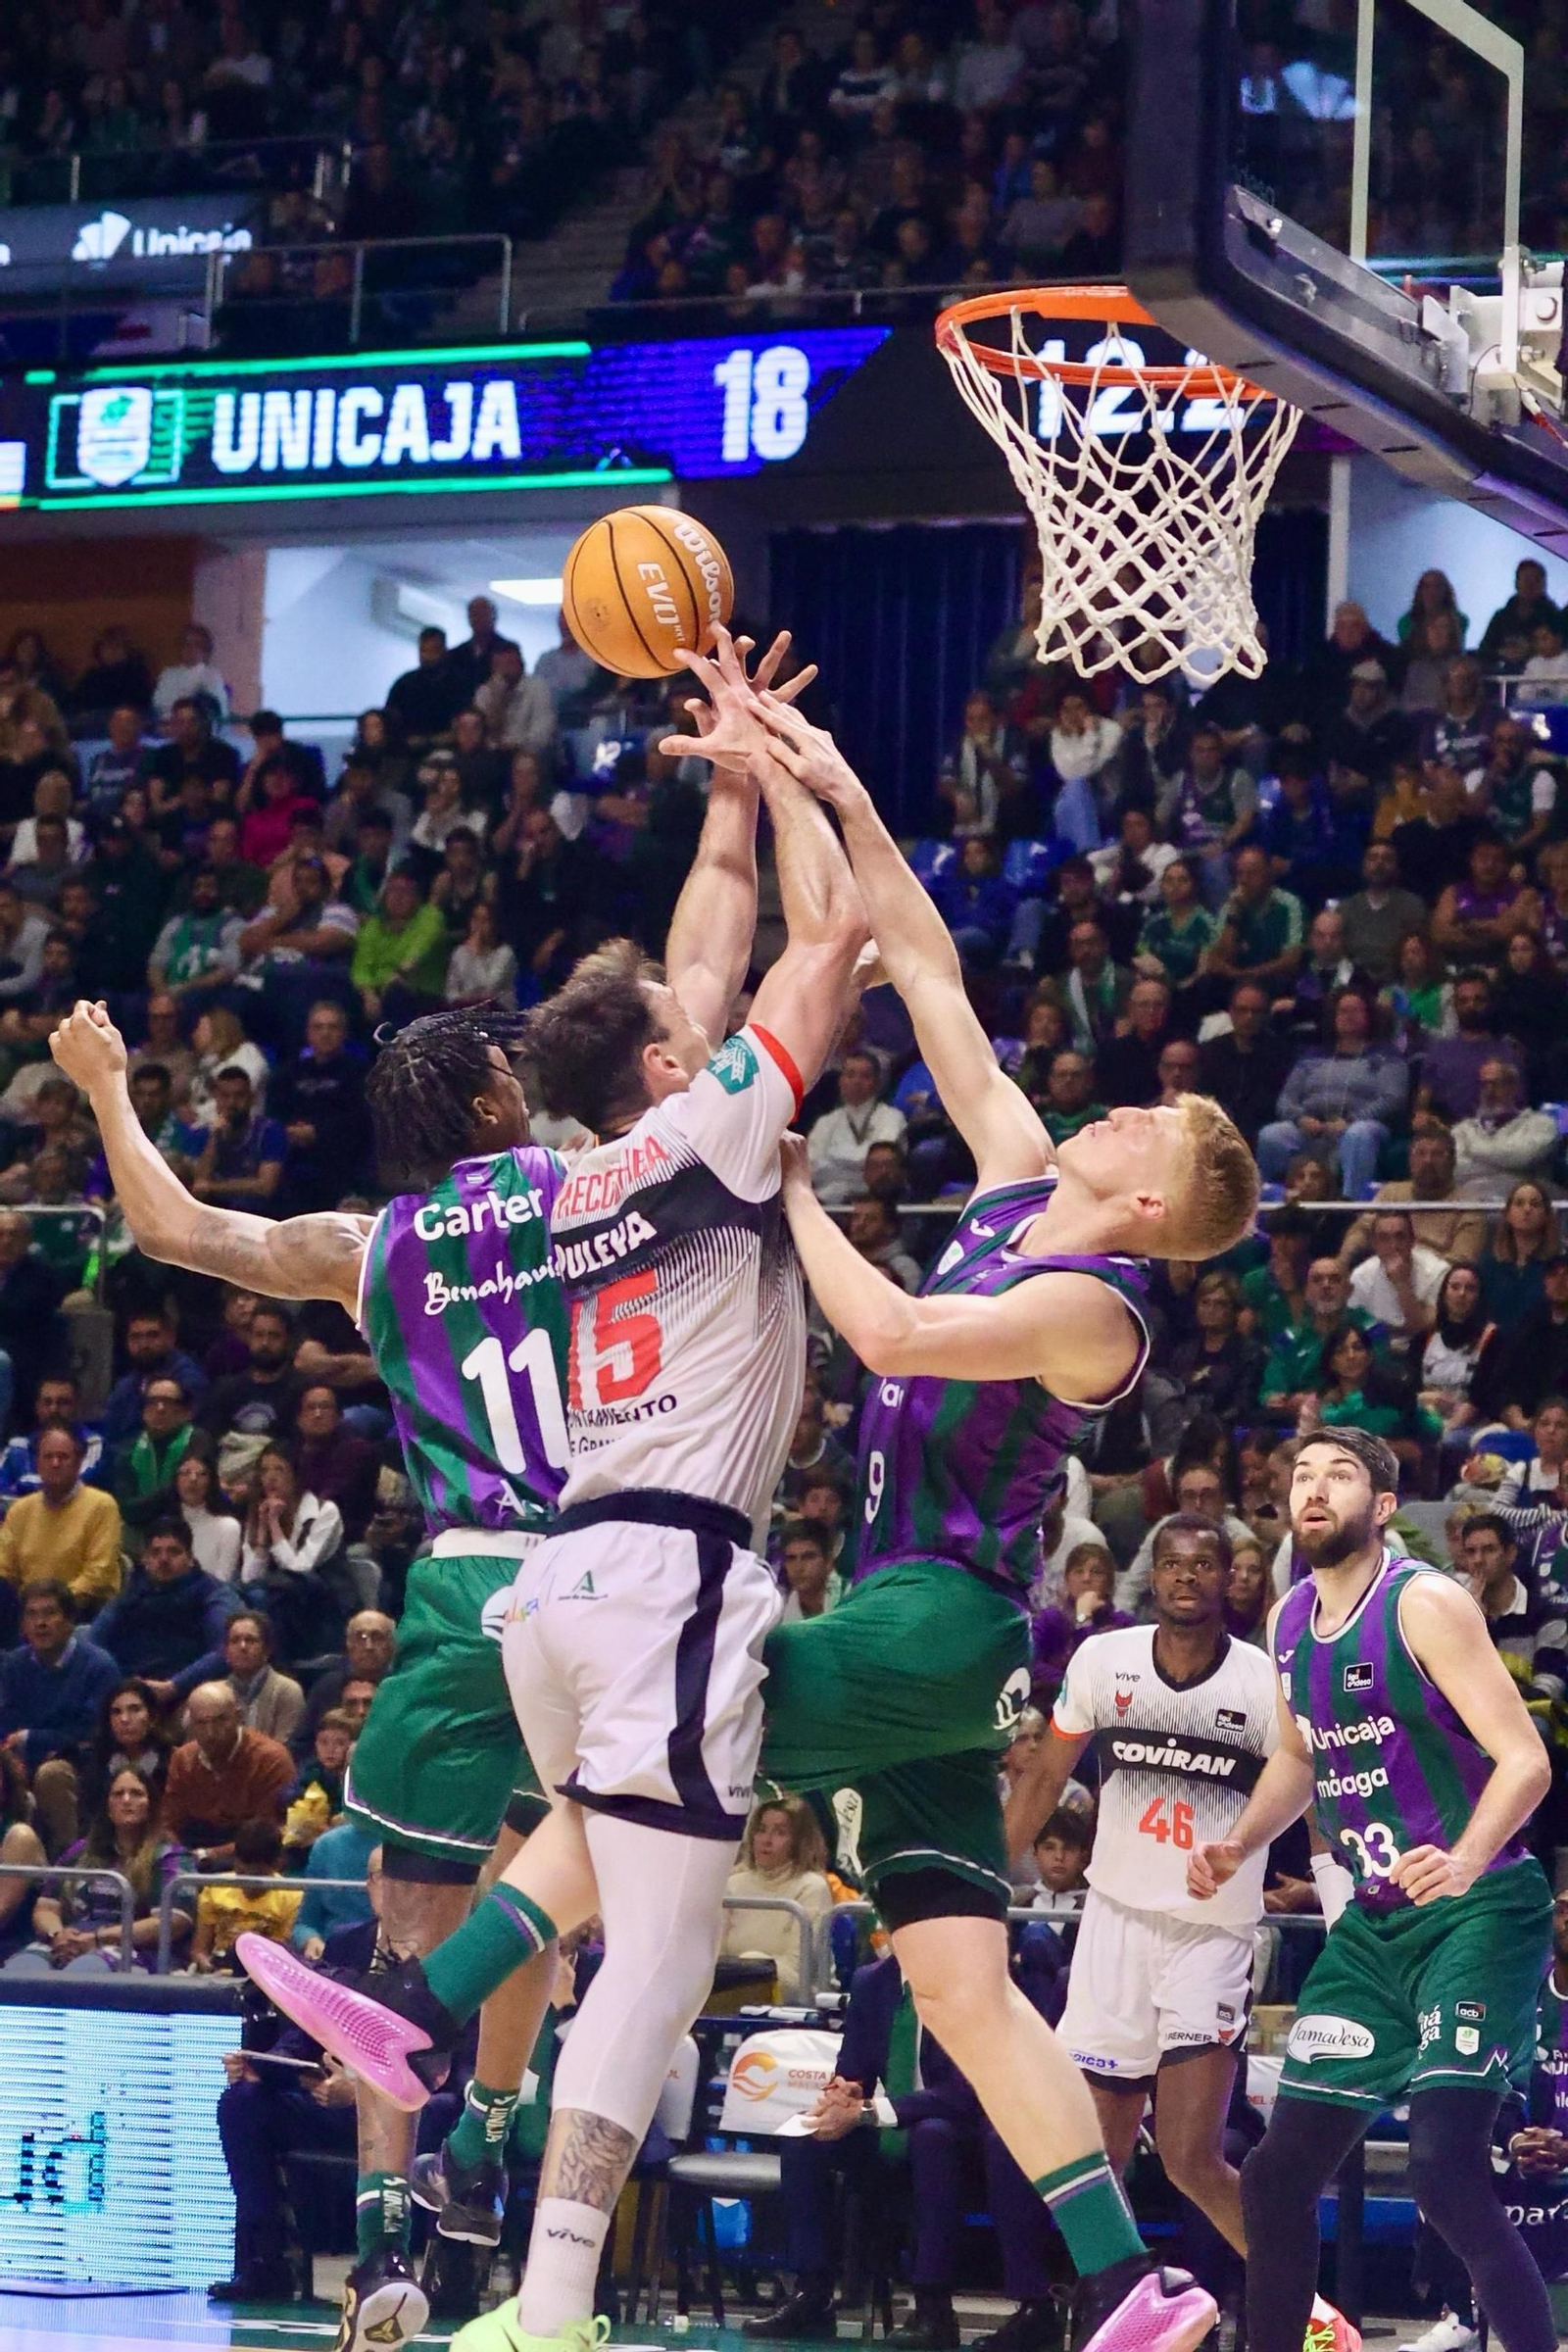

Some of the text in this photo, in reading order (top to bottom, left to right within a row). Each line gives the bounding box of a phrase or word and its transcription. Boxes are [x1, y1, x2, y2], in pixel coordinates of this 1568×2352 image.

[211, 379, 522, 473] UNICAJA
[713, 345, 810, 463] 18
[414, 1188, 543, 1242] Carter
[462, 1328, 571, 1475] 11
[864, 1450, 885, 1525] 9
[1310, 1715, 1396, 1750] Unicaja
[1139, 1795, 1195, 1850] 46
[1340, 1822, 1401, 1879] 33
[1459, 2008, 1480, 2018] acb
[788, 2069, 826, 2082] COSTA
